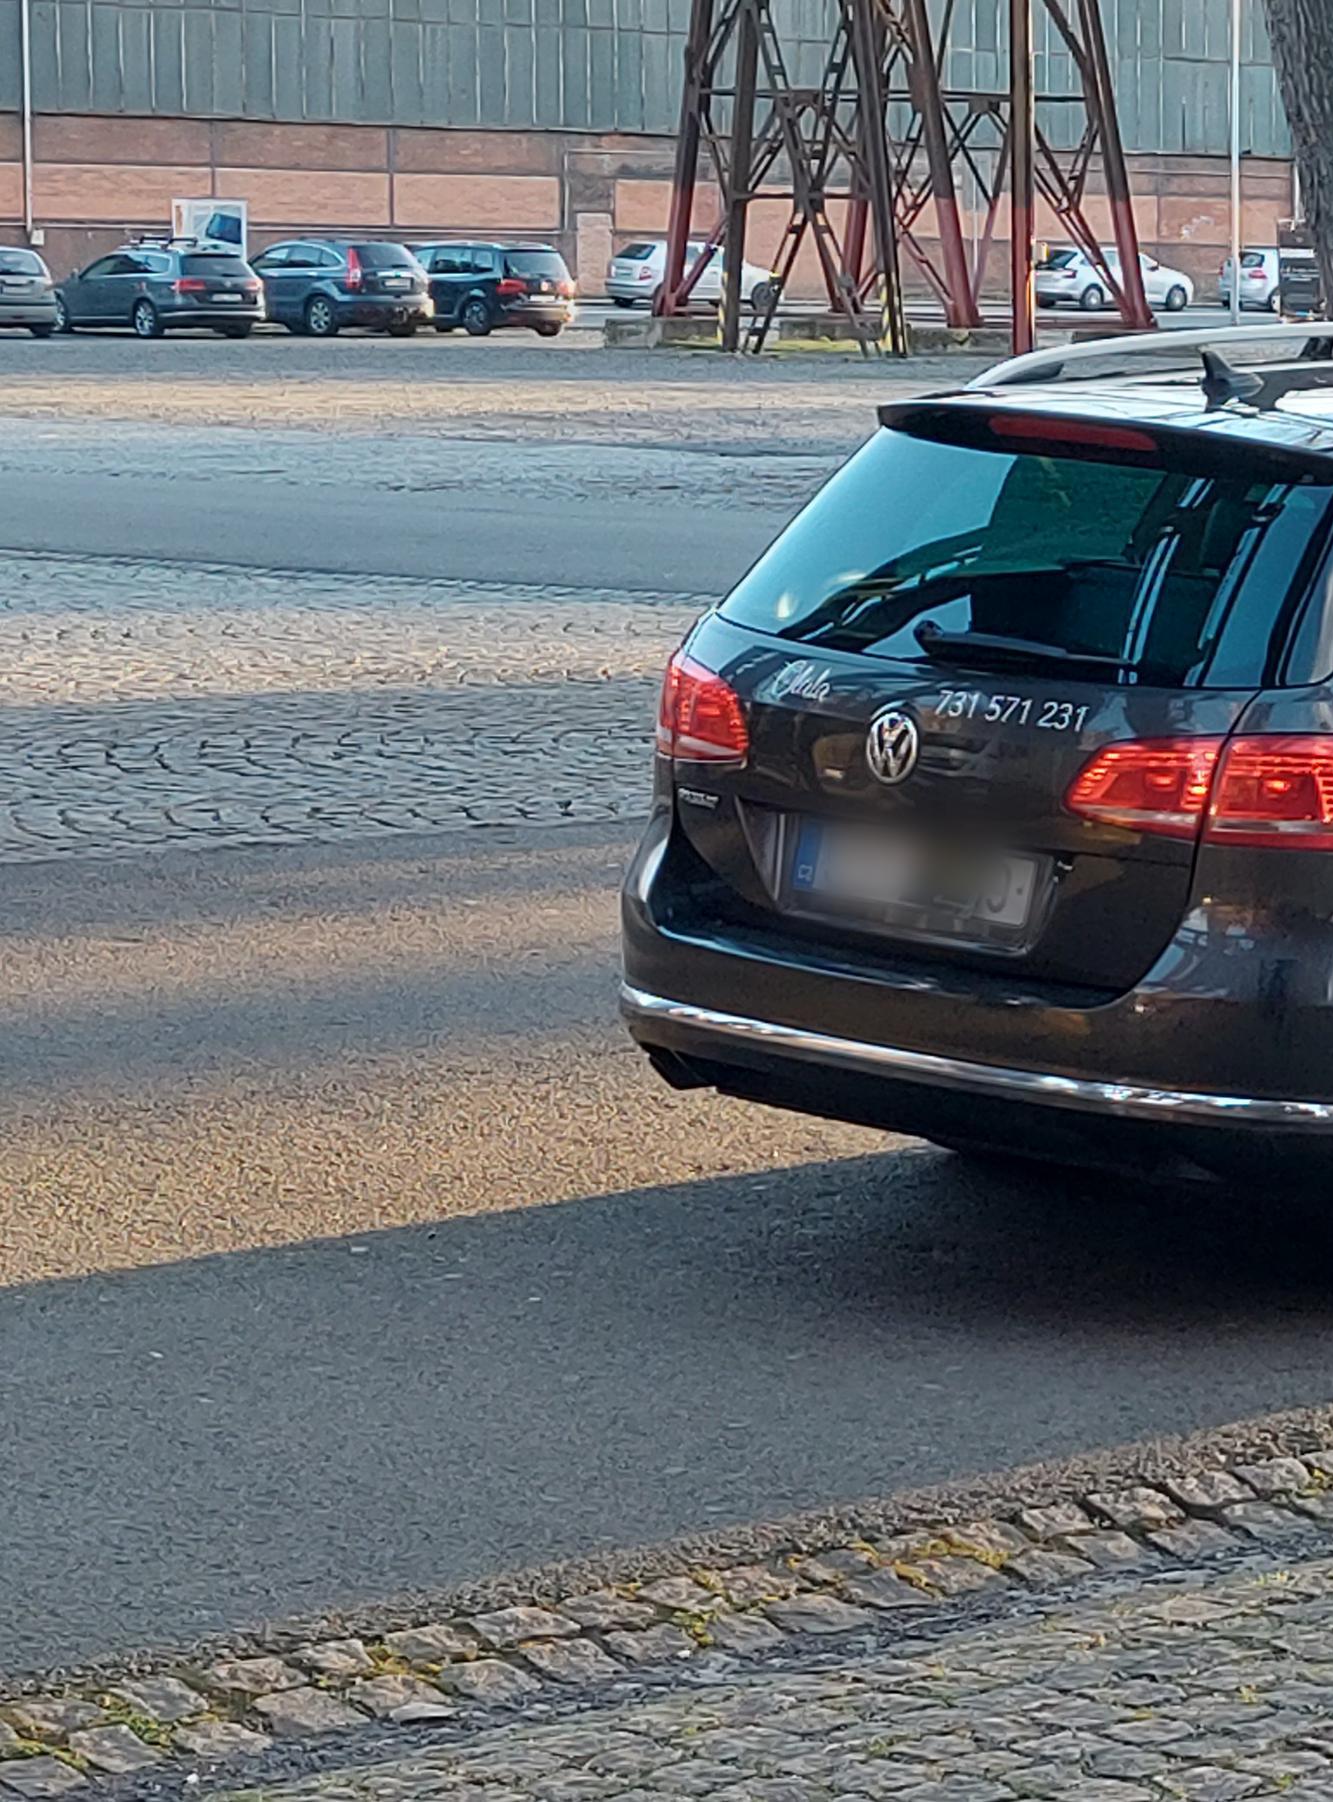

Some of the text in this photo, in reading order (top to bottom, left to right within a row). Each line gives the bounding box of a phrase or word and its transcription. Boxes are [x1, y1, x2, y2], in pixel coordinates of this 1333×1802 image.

[772, 659, 830, 702] Olala
[934, 689, 1090, 733] 731 571 231
